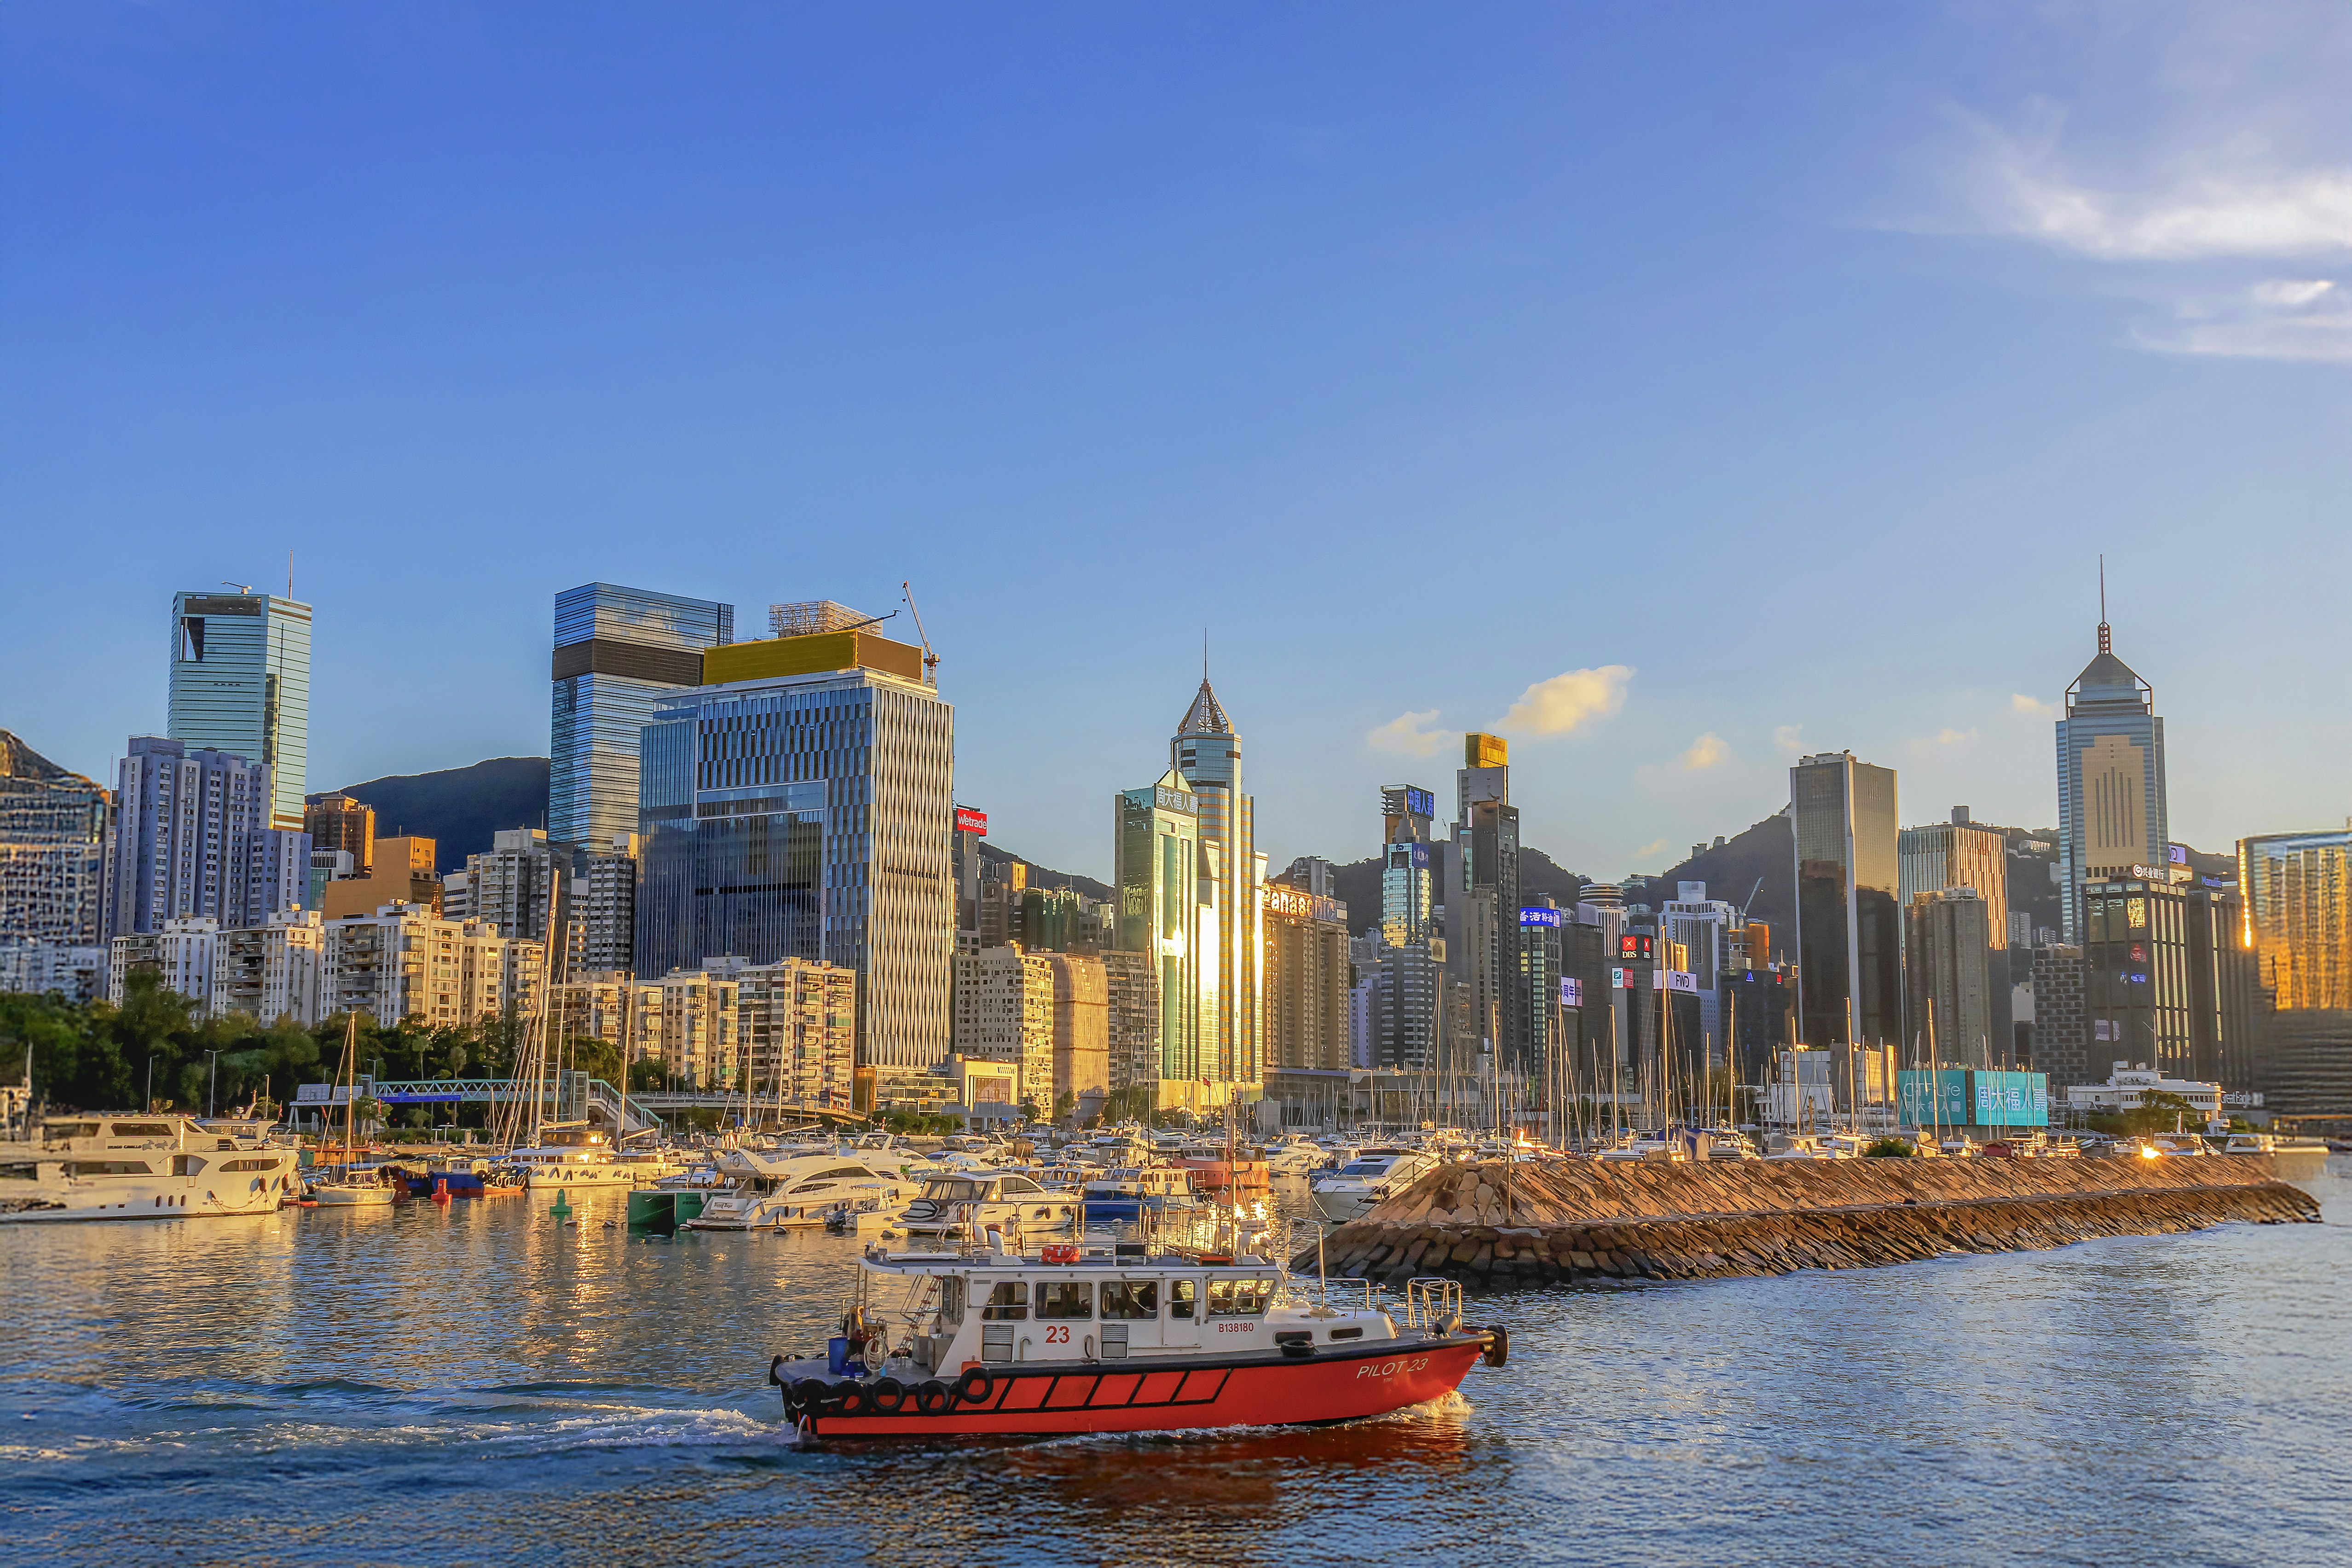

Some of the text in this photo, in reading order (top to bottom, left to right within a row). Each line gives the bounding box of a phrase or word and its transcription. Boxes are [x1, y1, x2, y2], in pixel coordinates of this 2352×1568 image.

[1156, 787, 1198, 814] 周大福人壽
[1407, 787, 1433, 817] 中国人寿
[2143, 867, 2164, 880] 兴业银行
[1262, 882, 1335, 922] Panasonic
[1676, 974, 1689, 988] FWD
[1977, 1086, 2047, 1112] 周大福人壽
[1045, 1325, 1070, 1343] 23
[1219, 1322, 1254, 1333] B138180
[1356, 1358, 1428, 1379] PILOT 23
